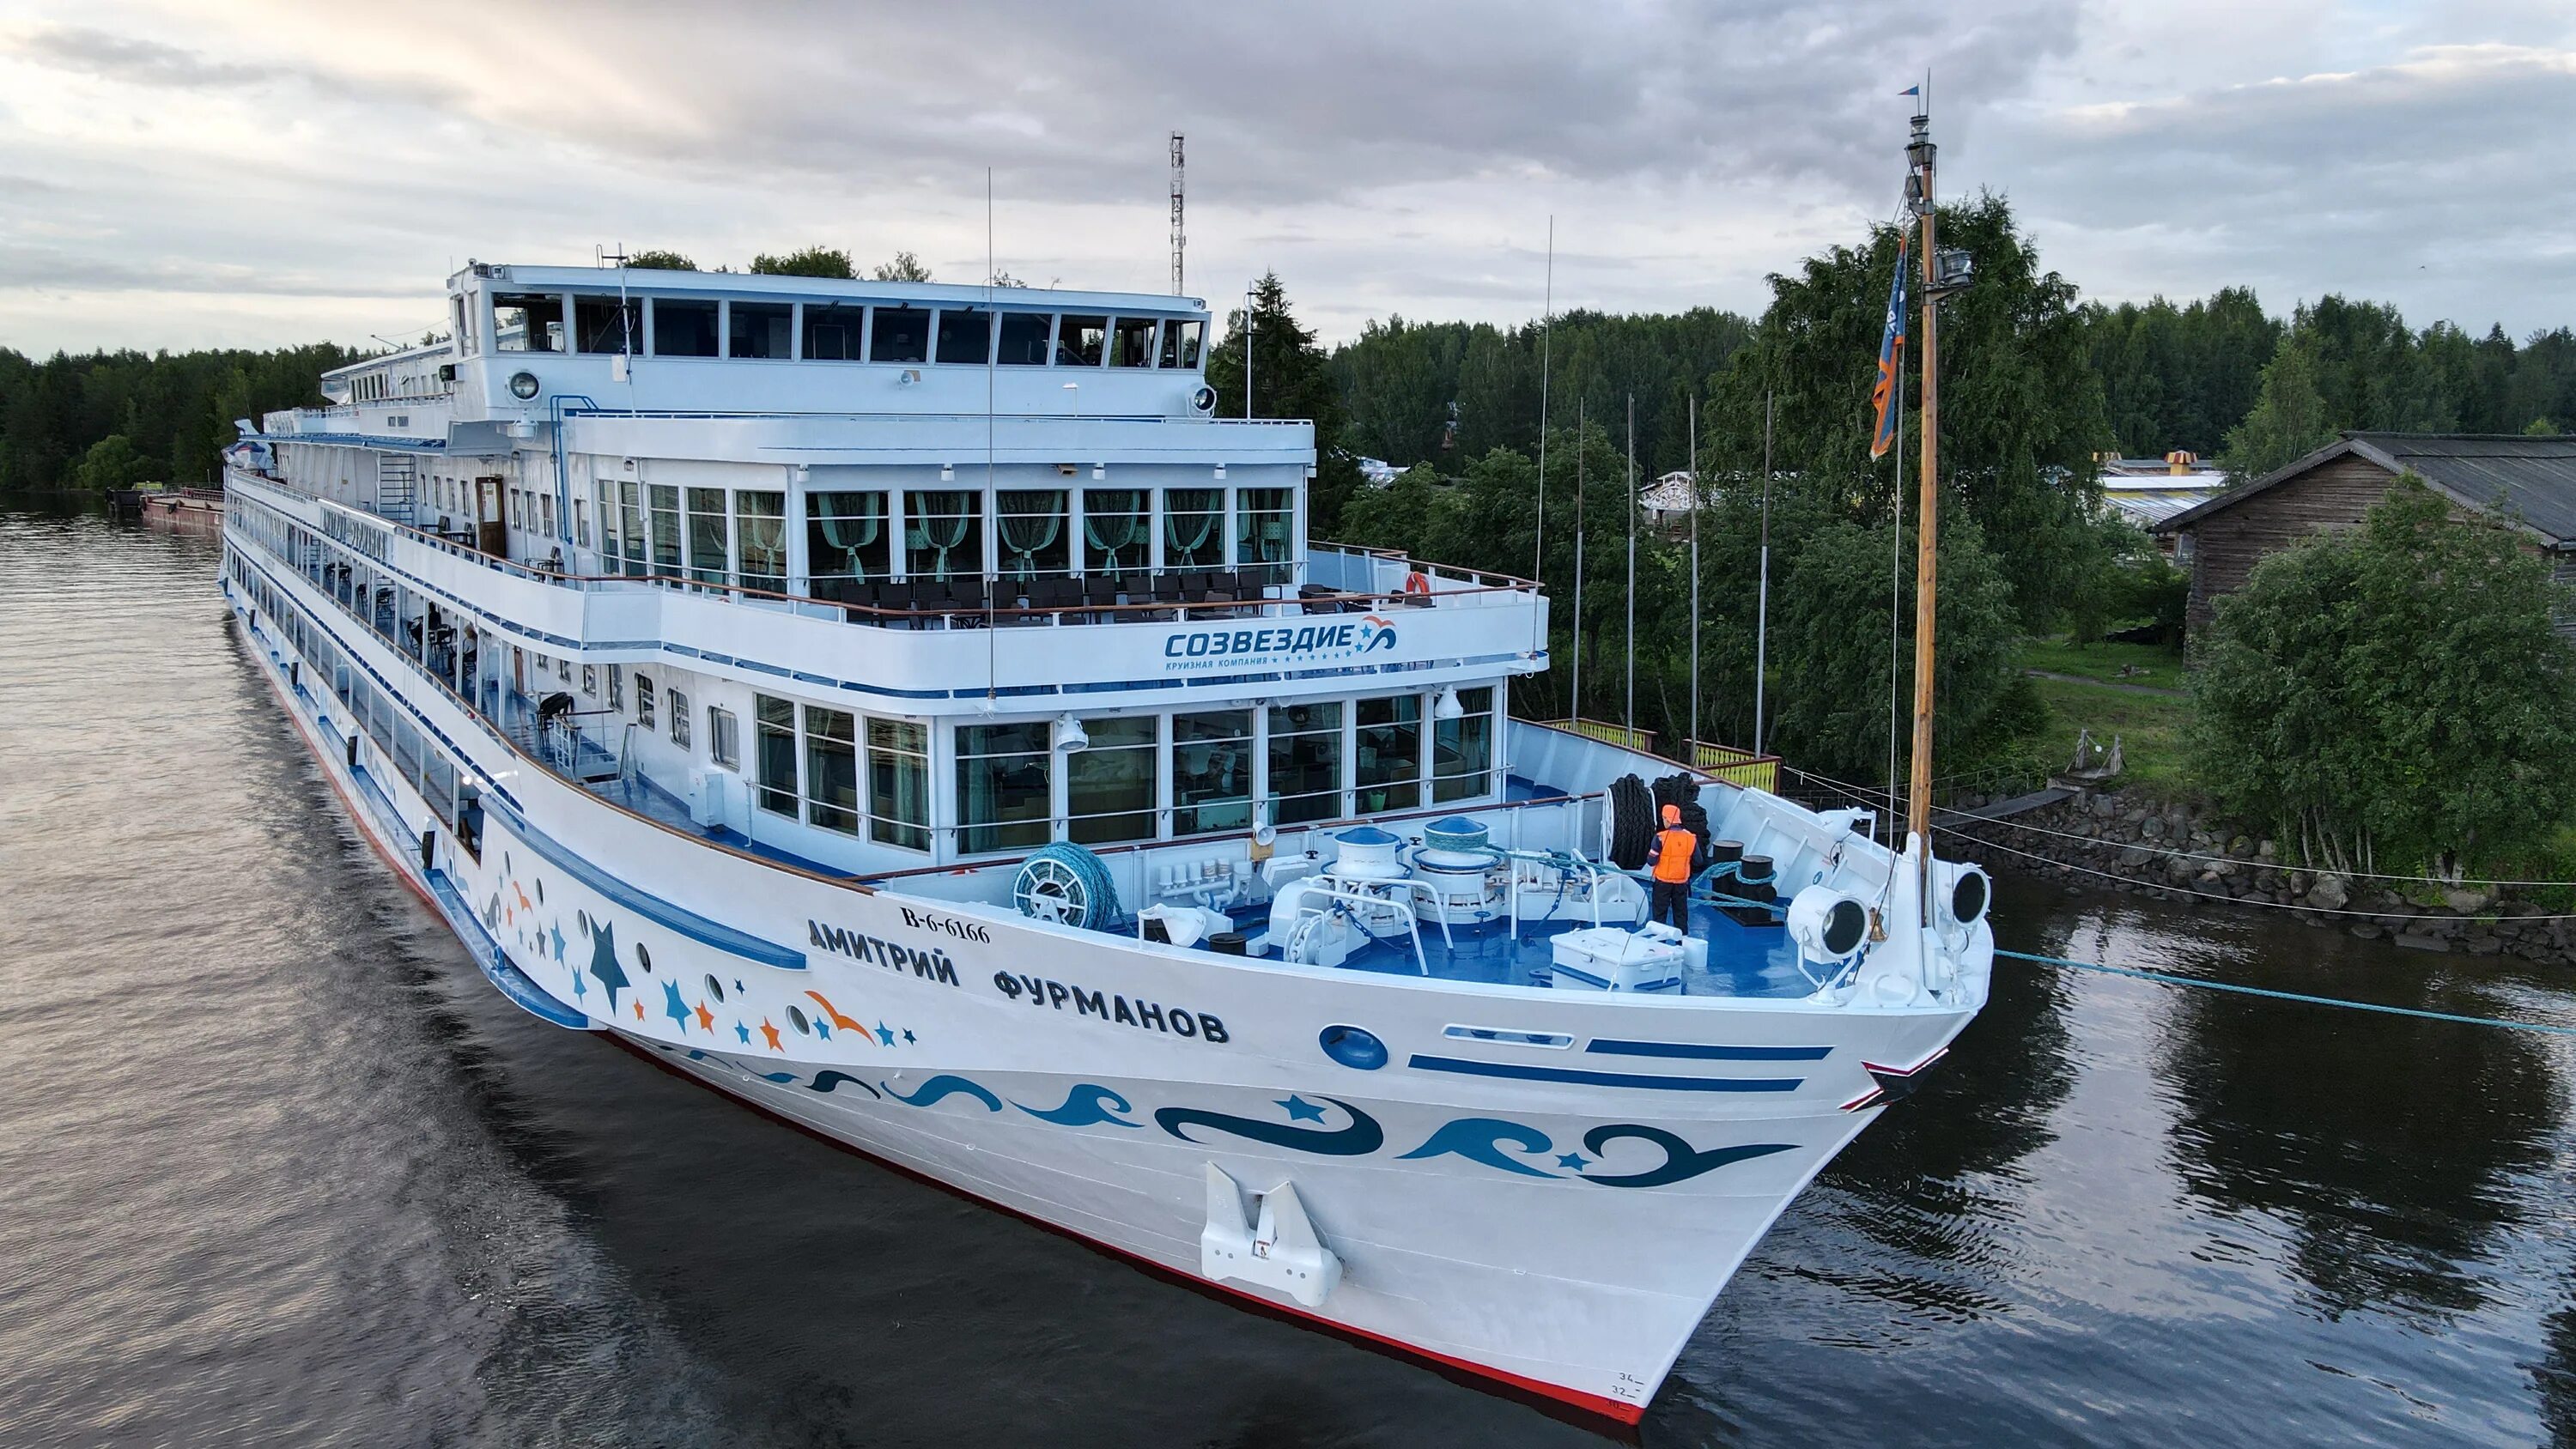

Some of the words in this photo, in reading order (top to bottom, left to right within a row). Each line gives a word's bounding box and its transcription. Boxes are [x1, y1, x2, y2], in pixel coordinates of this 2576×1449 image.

[1165, 625, 1355, 657] СОЗВЕЗДИЕ
[1166, 660, 1212, 670] КРУИЗНАЯ
[1218, 657, 1267, 667] КОМПАНИЯ
[808, 919, 960, 987] ДМИТРИЙ
[993, 970, 1230, 1044] ФУРМАНОВ
[1619, 1372, 1633, 1382] 34
[1612, 1385, 1625, 1396] 32
